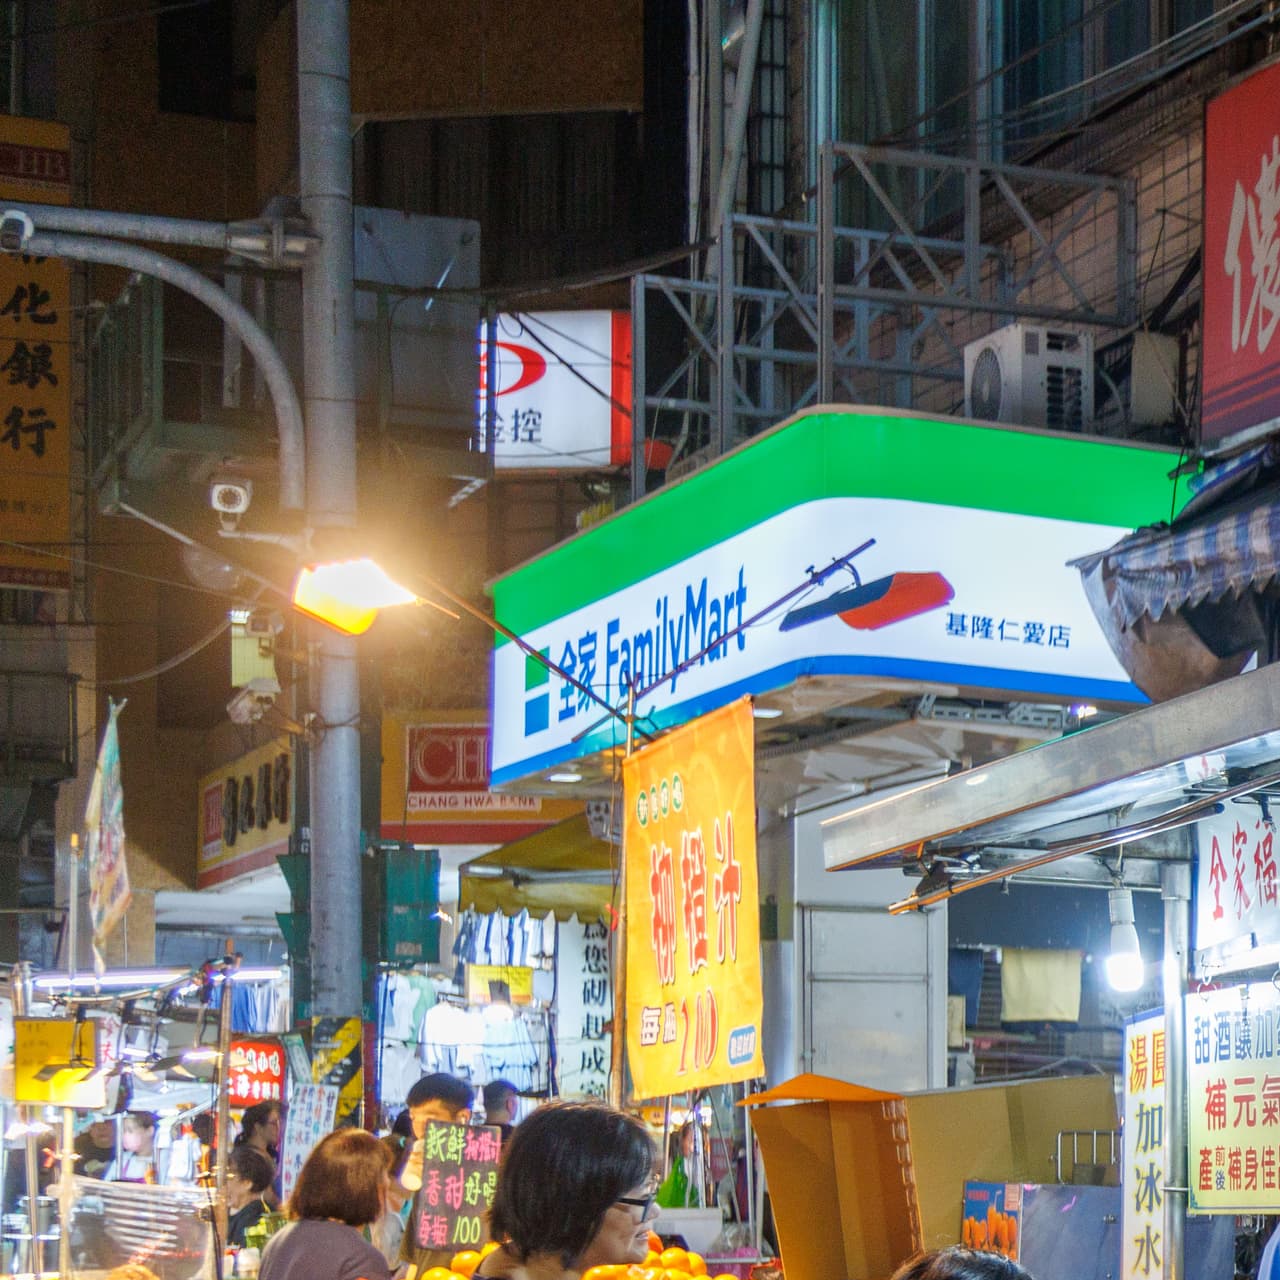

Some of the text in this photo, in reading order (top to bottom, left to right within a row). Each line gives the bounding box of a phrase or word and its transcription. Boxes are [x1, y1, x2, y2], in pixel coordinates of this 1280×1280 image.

[0, 250, 58, 458] 化銀行
[558, 564, 748, 722] 全家 FamilyMart
[945, 610, 1072, 649] 基隆仁愛店
[408, 794, 459, 809] CHANG
[464, 794, 494, 808] HWA
[650, 811, 741, 985] 柳橙汁
[640, 985, 718, 1075] 每瓶 100
[1129, 1030, 1165, 1095] 湯圓
[452, 1215, 481, 1244] 100
[1134, 1102, 1164, 1276] 加冰水
